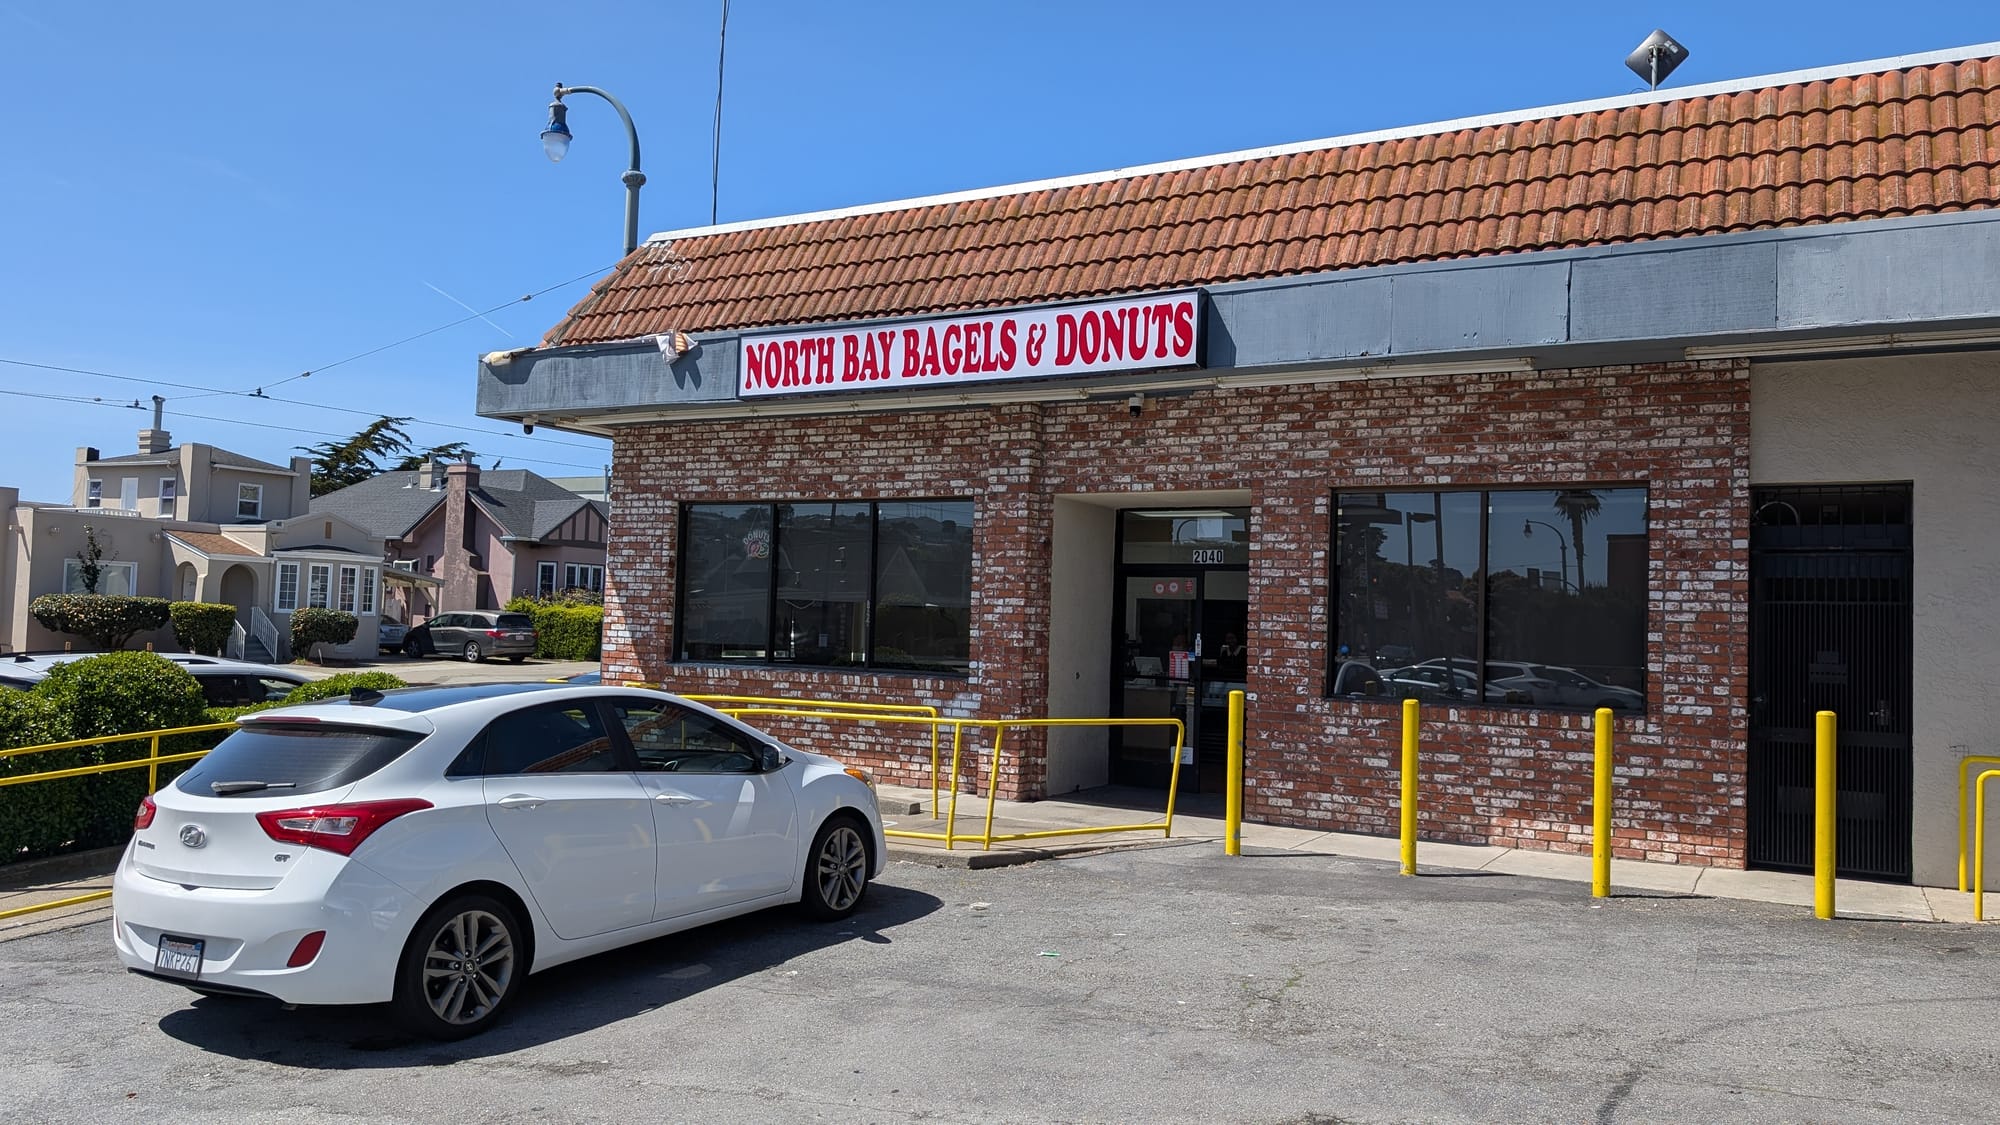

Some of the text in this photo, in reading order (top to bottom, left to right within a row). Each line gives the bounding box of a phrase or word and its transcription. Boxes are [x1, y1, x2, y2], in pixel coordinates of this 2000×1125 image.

[745, 301, 1194, 389] NORTH BAY BAGELS & DONUTS
[1194, 550, 1223, 563] 2040
[159, 949, 200, 973] 7NKP267
